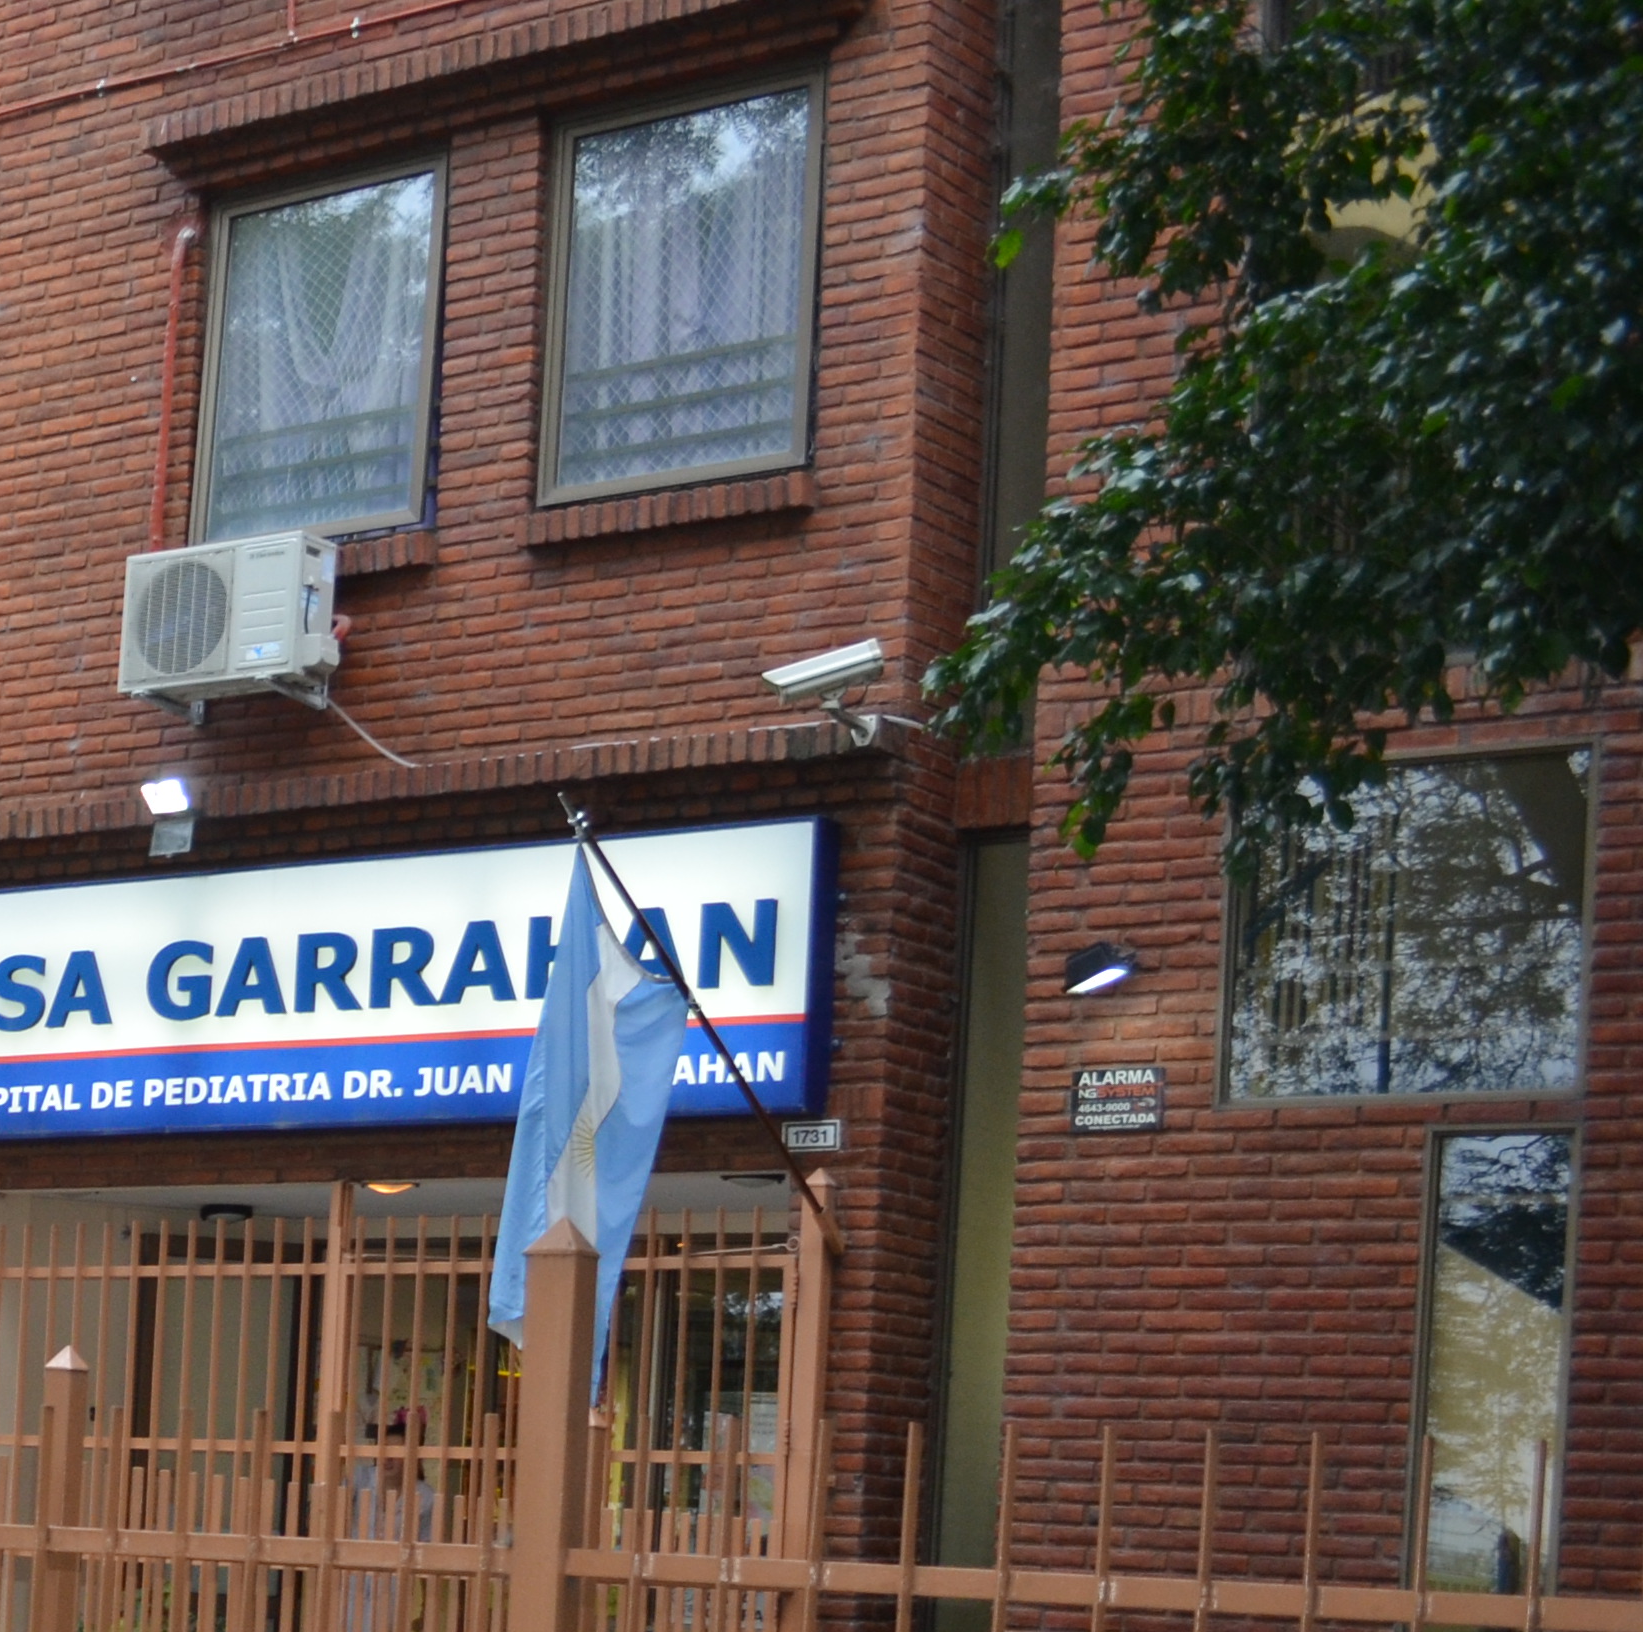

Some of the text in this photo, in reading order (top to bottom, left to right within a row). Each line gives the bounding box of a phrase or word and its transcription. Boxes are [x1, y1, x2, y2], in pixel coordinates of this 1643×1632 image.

[90, 1080, 133, 1109] DE
[143, 1072, 332, 1107] PEDIATRIA
[343, 1069, 403, 1100] DR.
[413, 1063, 513, 1097] JUAN
[1078, 1068, 1155, 1087] ALARMA
[1075, 1113, 1156, 1126] CONECTADA
[793, 1129, 827, 1144] 1731
